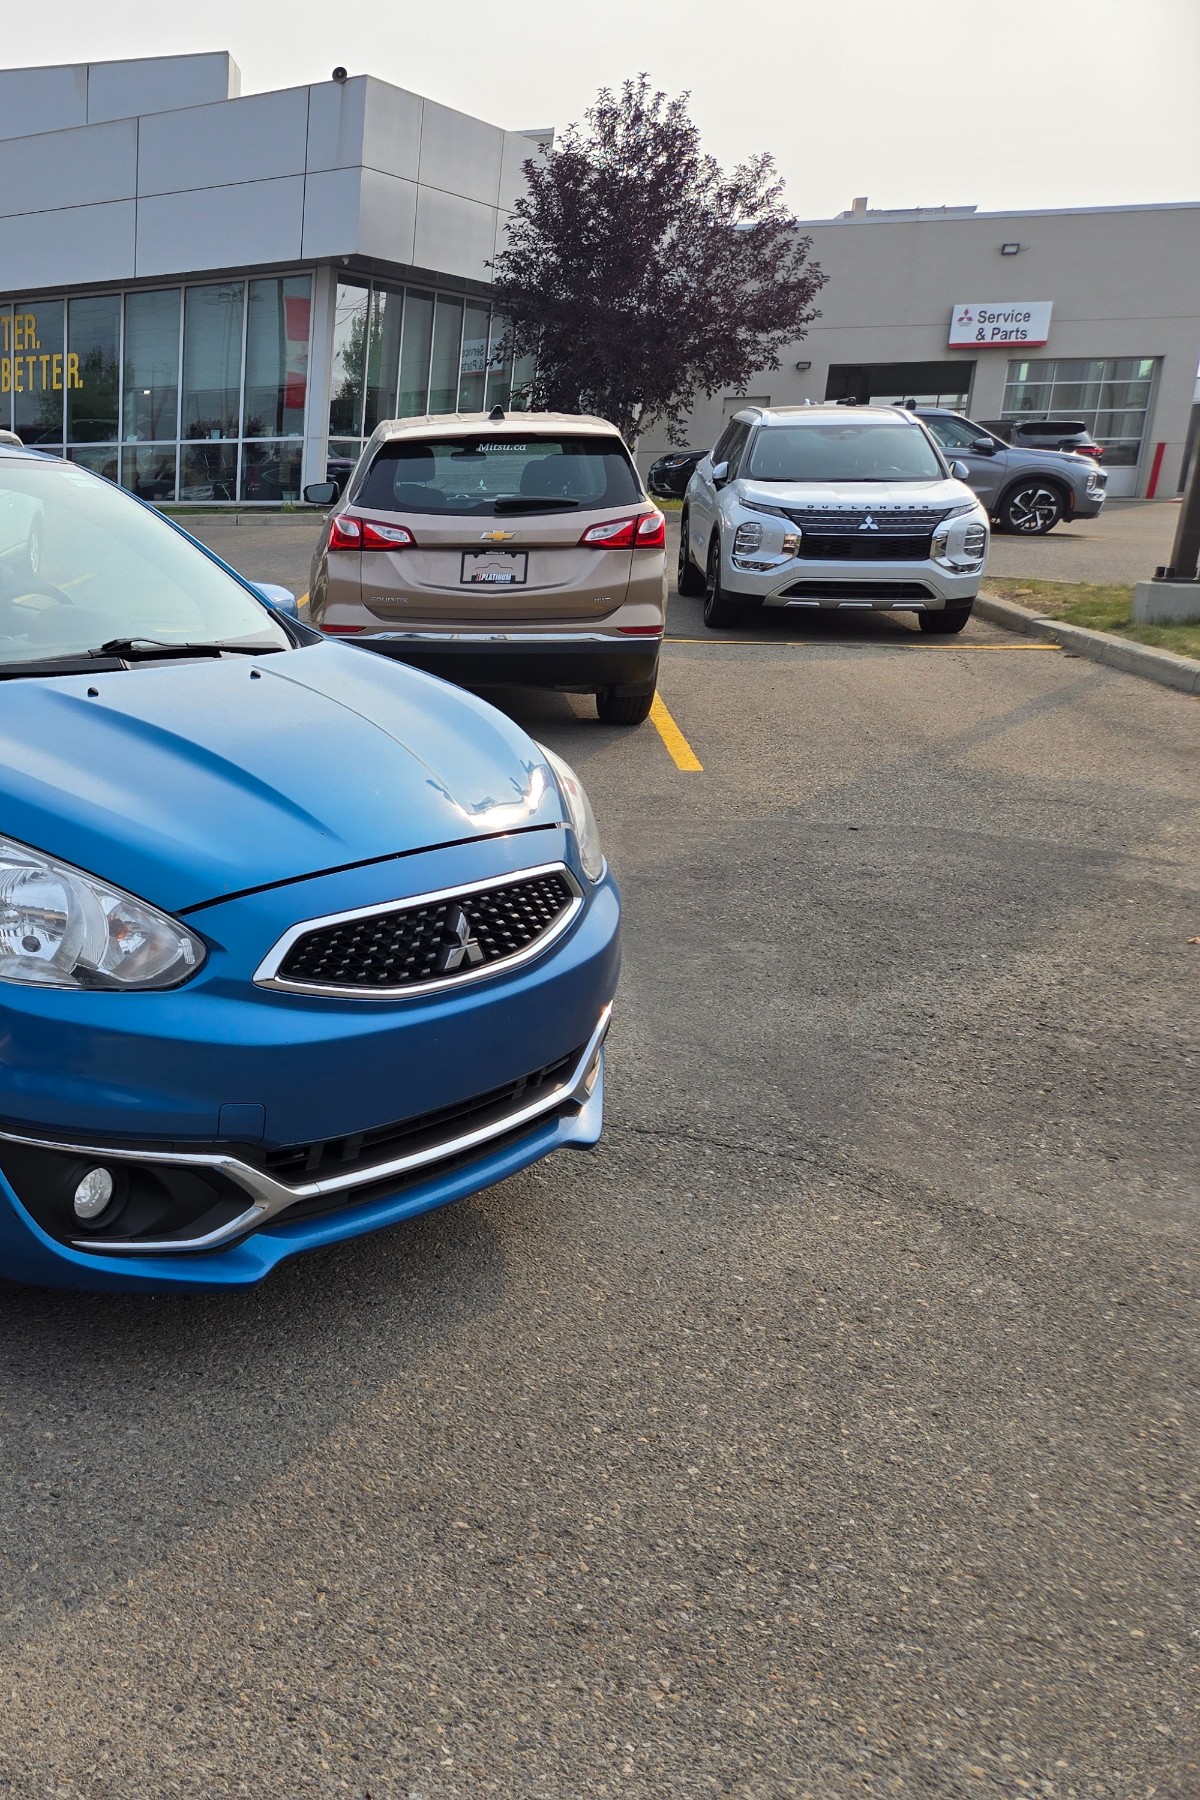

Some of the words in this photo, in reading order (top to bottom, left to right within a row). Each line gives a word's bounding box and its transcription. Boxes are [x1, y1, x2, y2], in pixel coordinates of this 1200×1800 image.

[977, 309, 1031, 324] Service
[975, 327, 986, 341] &
[990, 327, 1028, 341] Parts
[1, 352, 84, 393] BETTER.
[478, 443, 527, 451] Mitsu.ca
